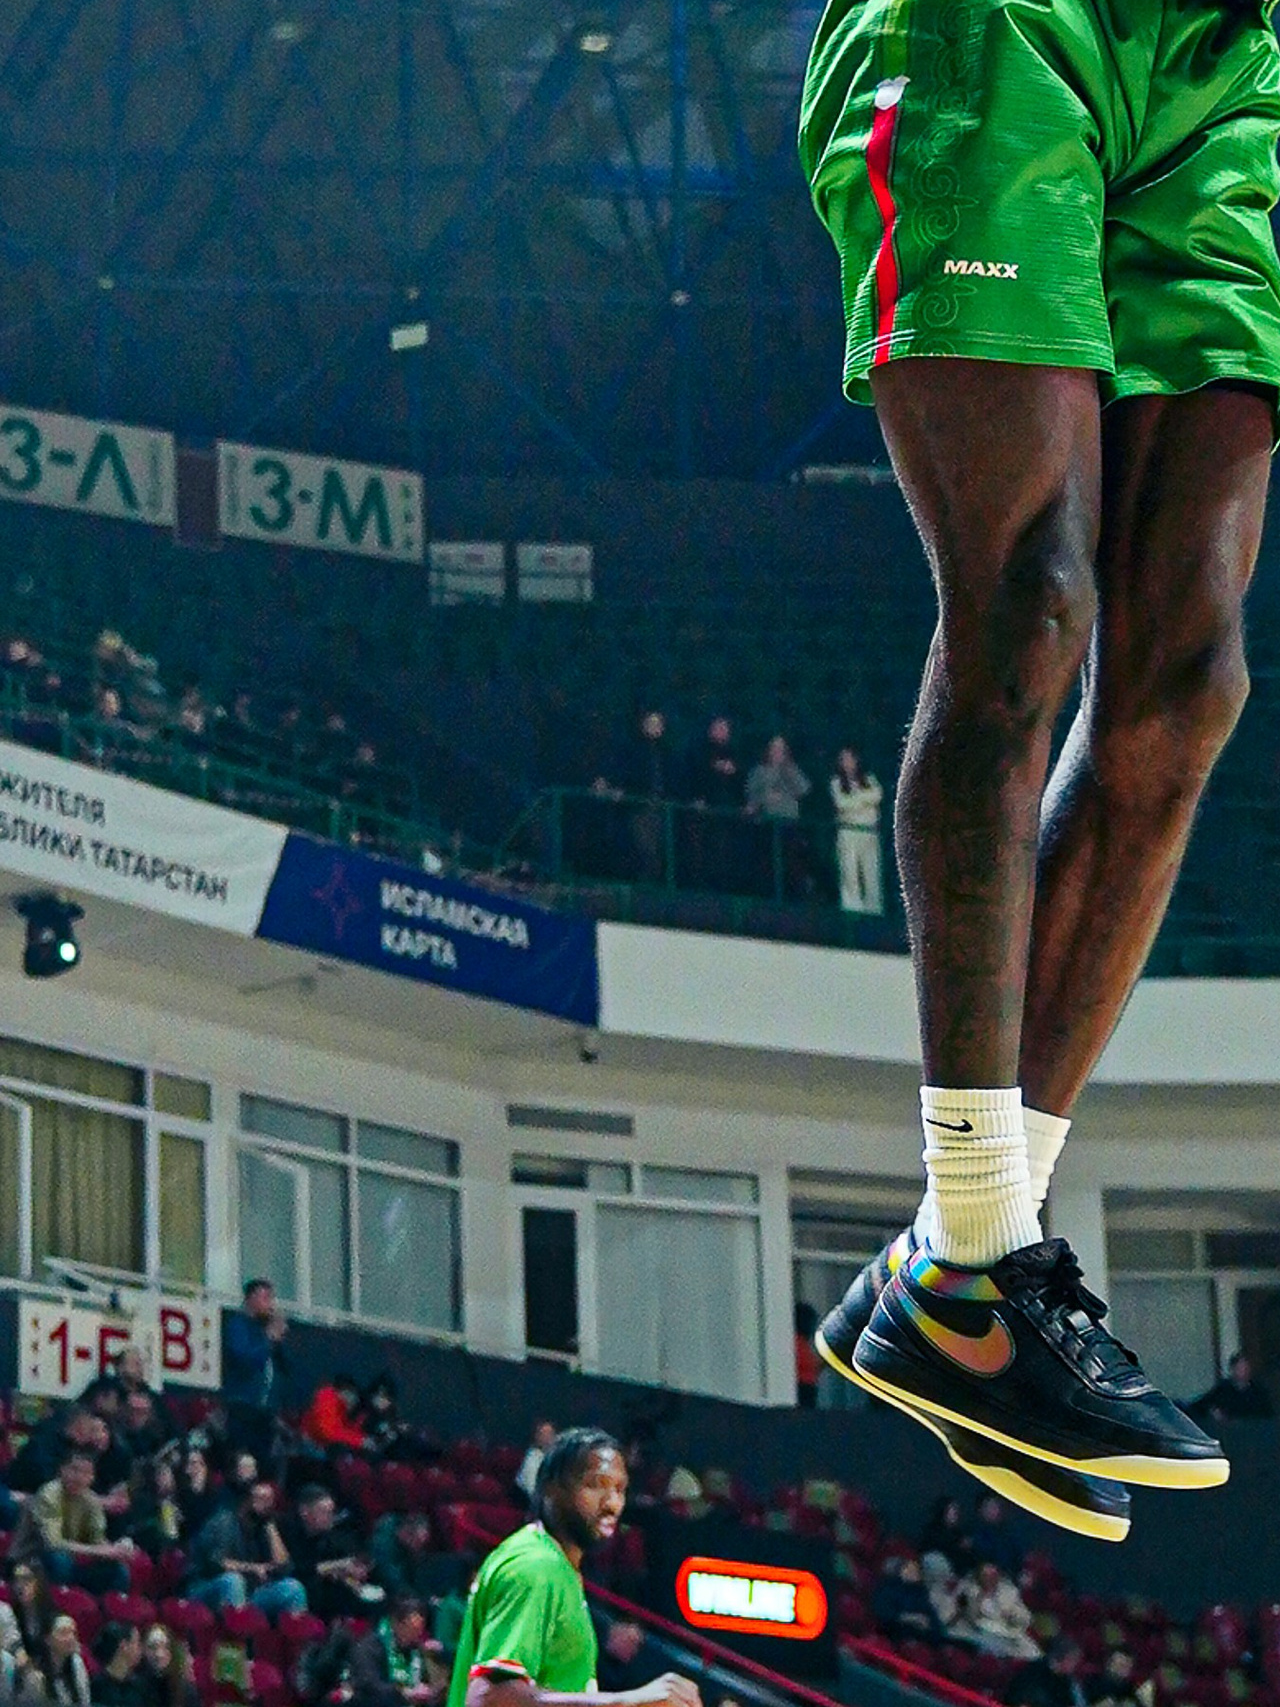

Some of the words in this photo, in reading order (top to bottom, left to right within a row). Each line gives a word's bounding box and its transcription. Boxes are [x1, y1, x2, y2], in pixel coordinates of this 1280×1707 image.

[943, 259, 1019, 280] MAXX
[90, 839, 229, 905] ТАТАРСТАН
[381, 923, 457, 970] КАРТА
